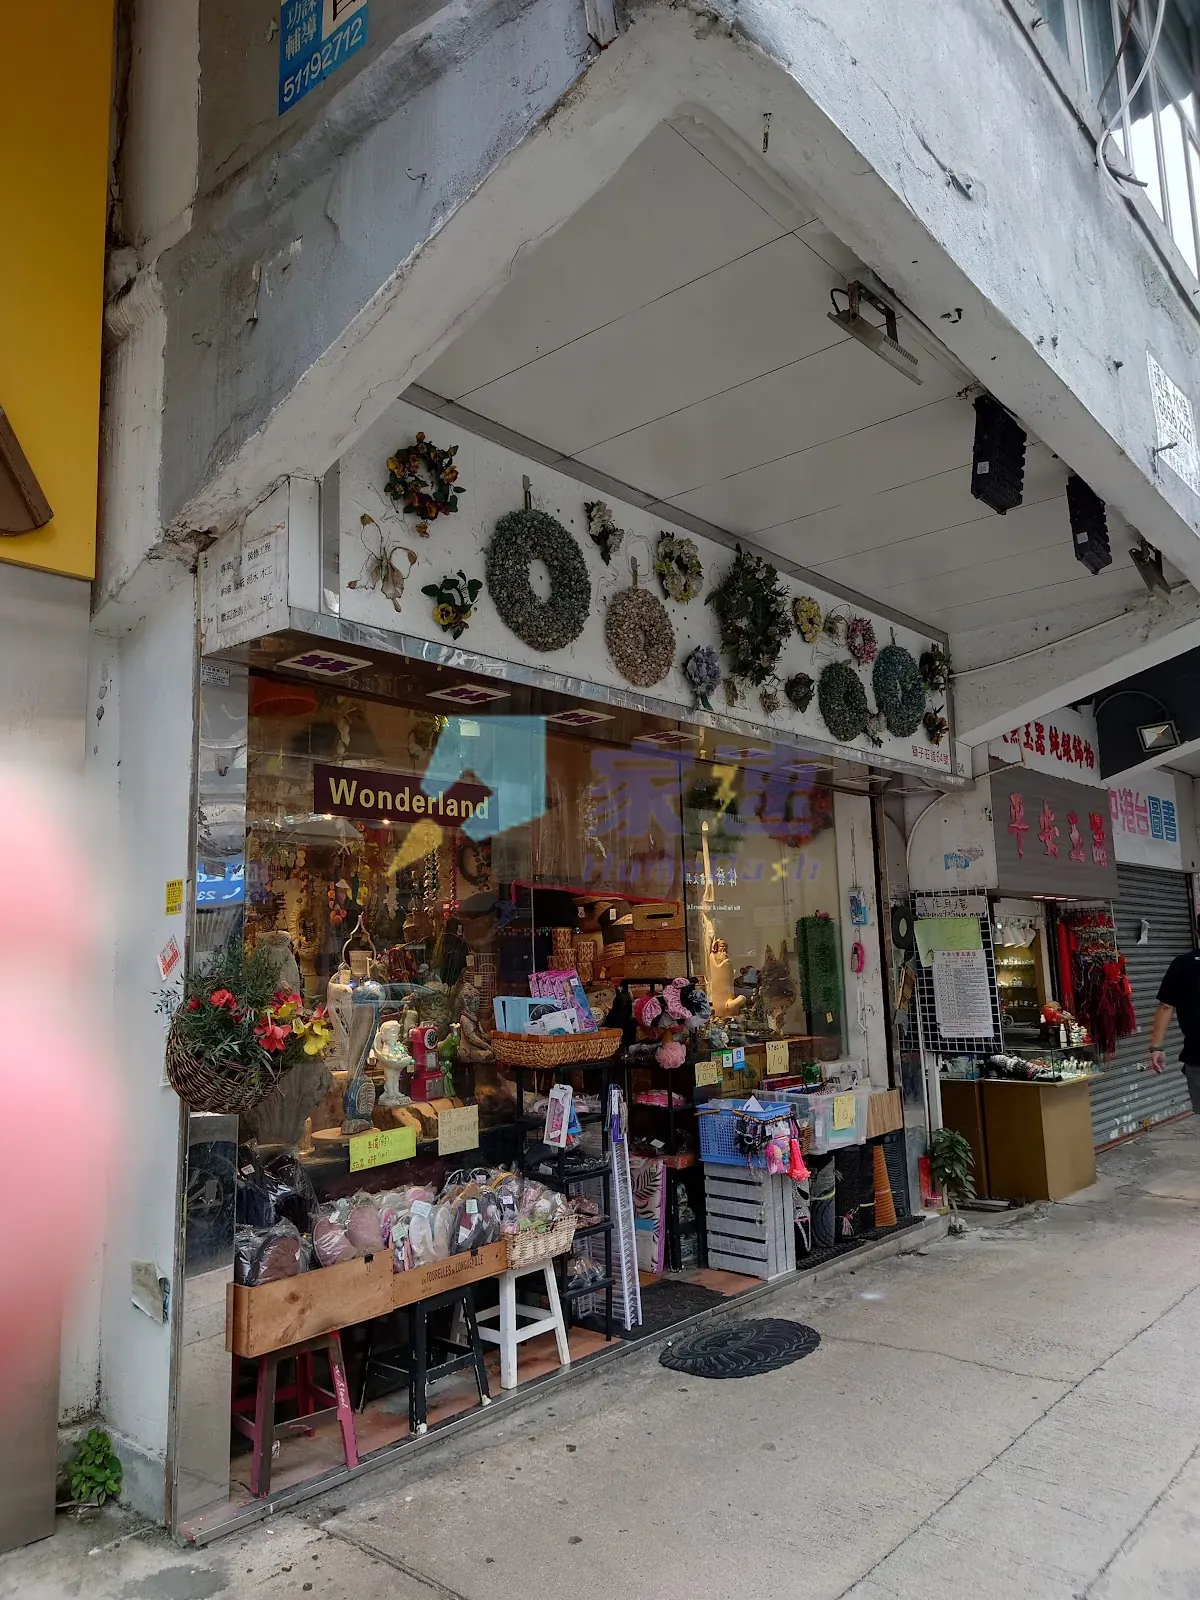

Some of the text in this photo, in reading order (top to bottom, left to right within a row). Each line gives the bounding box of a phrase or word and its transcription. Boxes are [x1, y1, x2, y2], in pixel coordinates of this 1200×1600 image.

[283, 17, 363, 103] 51192712
[285, 13, 317, 61] 輔導
[328, 777, 489, 820] Wonderland
[1007, 792, 1109, 868] 平安玉器
